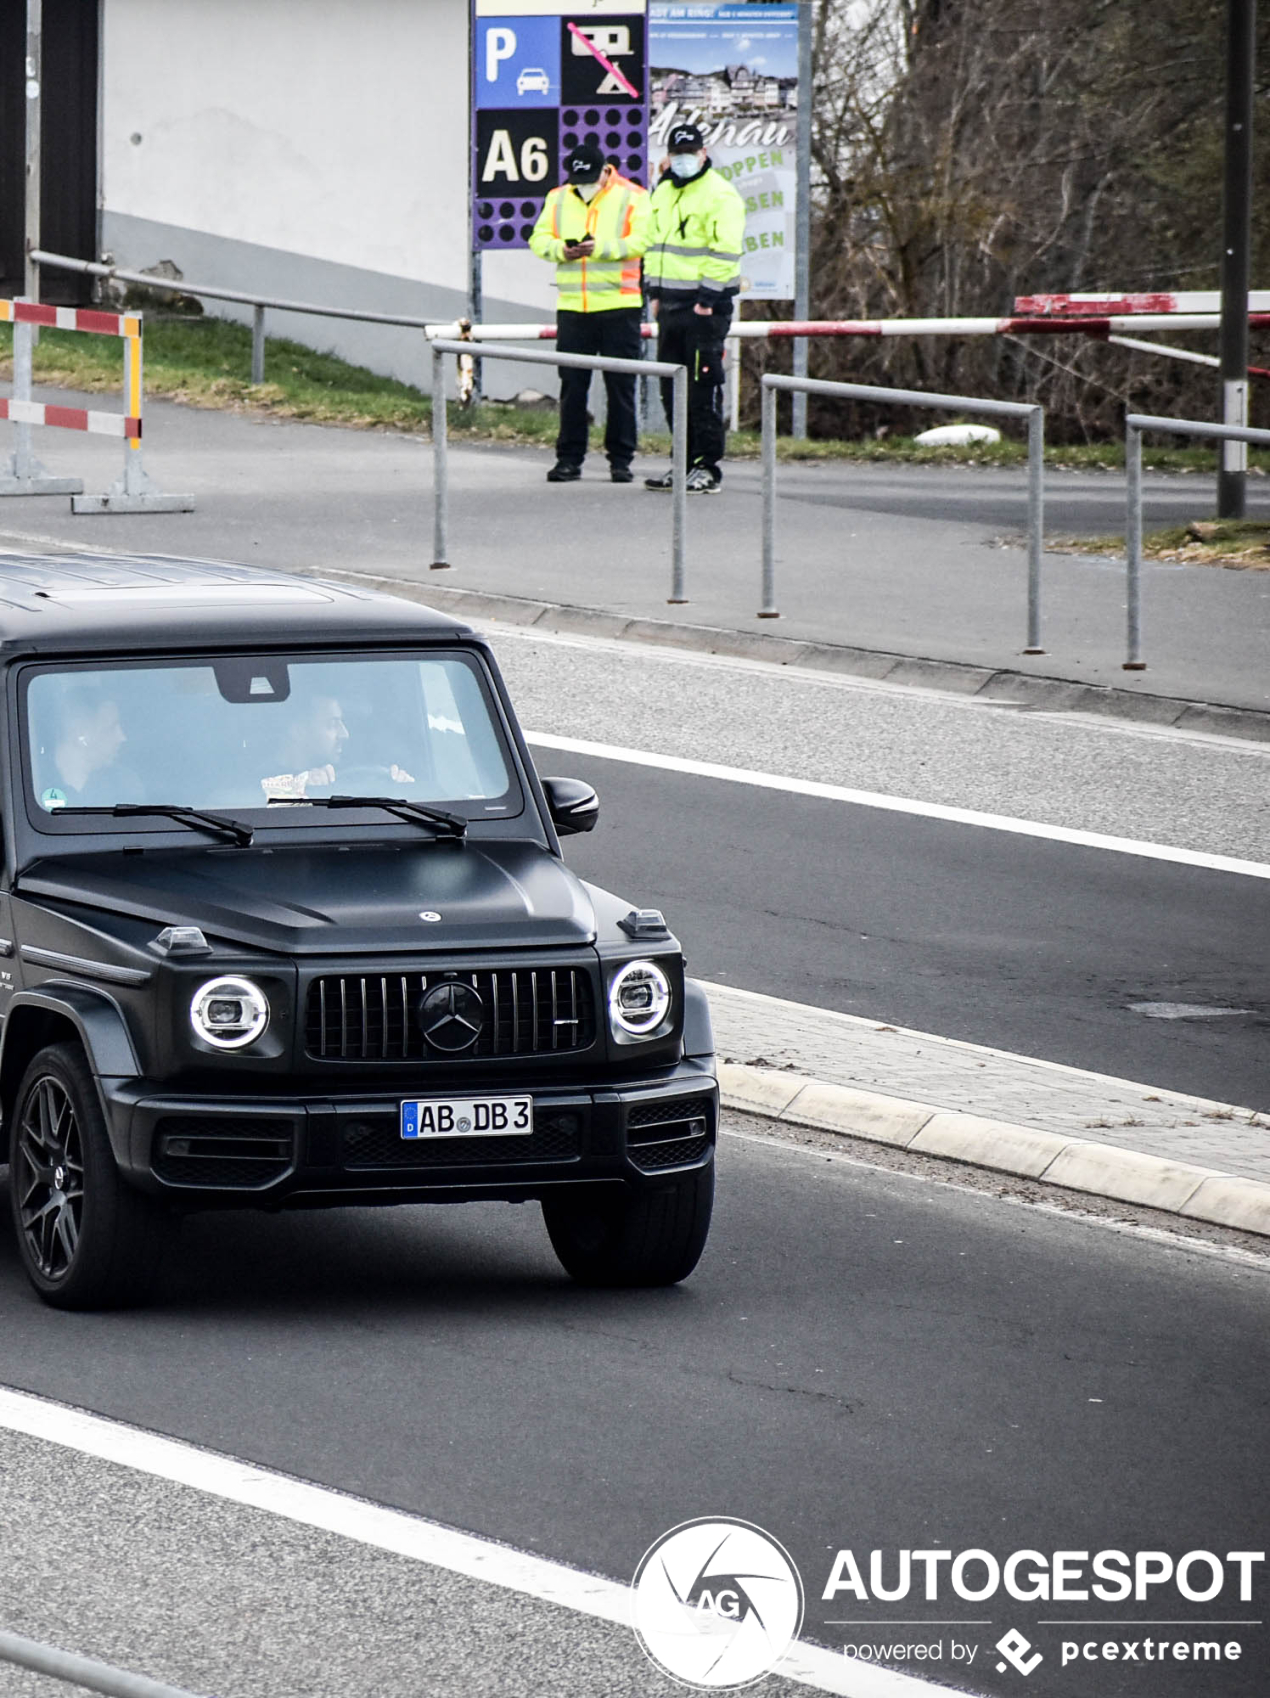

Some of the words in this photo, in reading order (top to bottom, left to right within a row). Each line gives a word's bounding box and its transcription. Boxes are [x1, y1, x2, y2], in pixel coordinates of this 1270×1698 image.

[486, 28, 517, 82] P
[482, 129, 548, 182] A6
[716, 150, 784, 182] OPPEN
[745, 191, 784, 216] SEN
[744, 232, 784, 252] BEN
[50, 789, 57, 800] 4
[407, 1123, 414, 1132] D
[420, 1105, 454, 1133] AB
[473, 1103, 508, 1131] DB
[513, 1101, 529, 1129] 3
